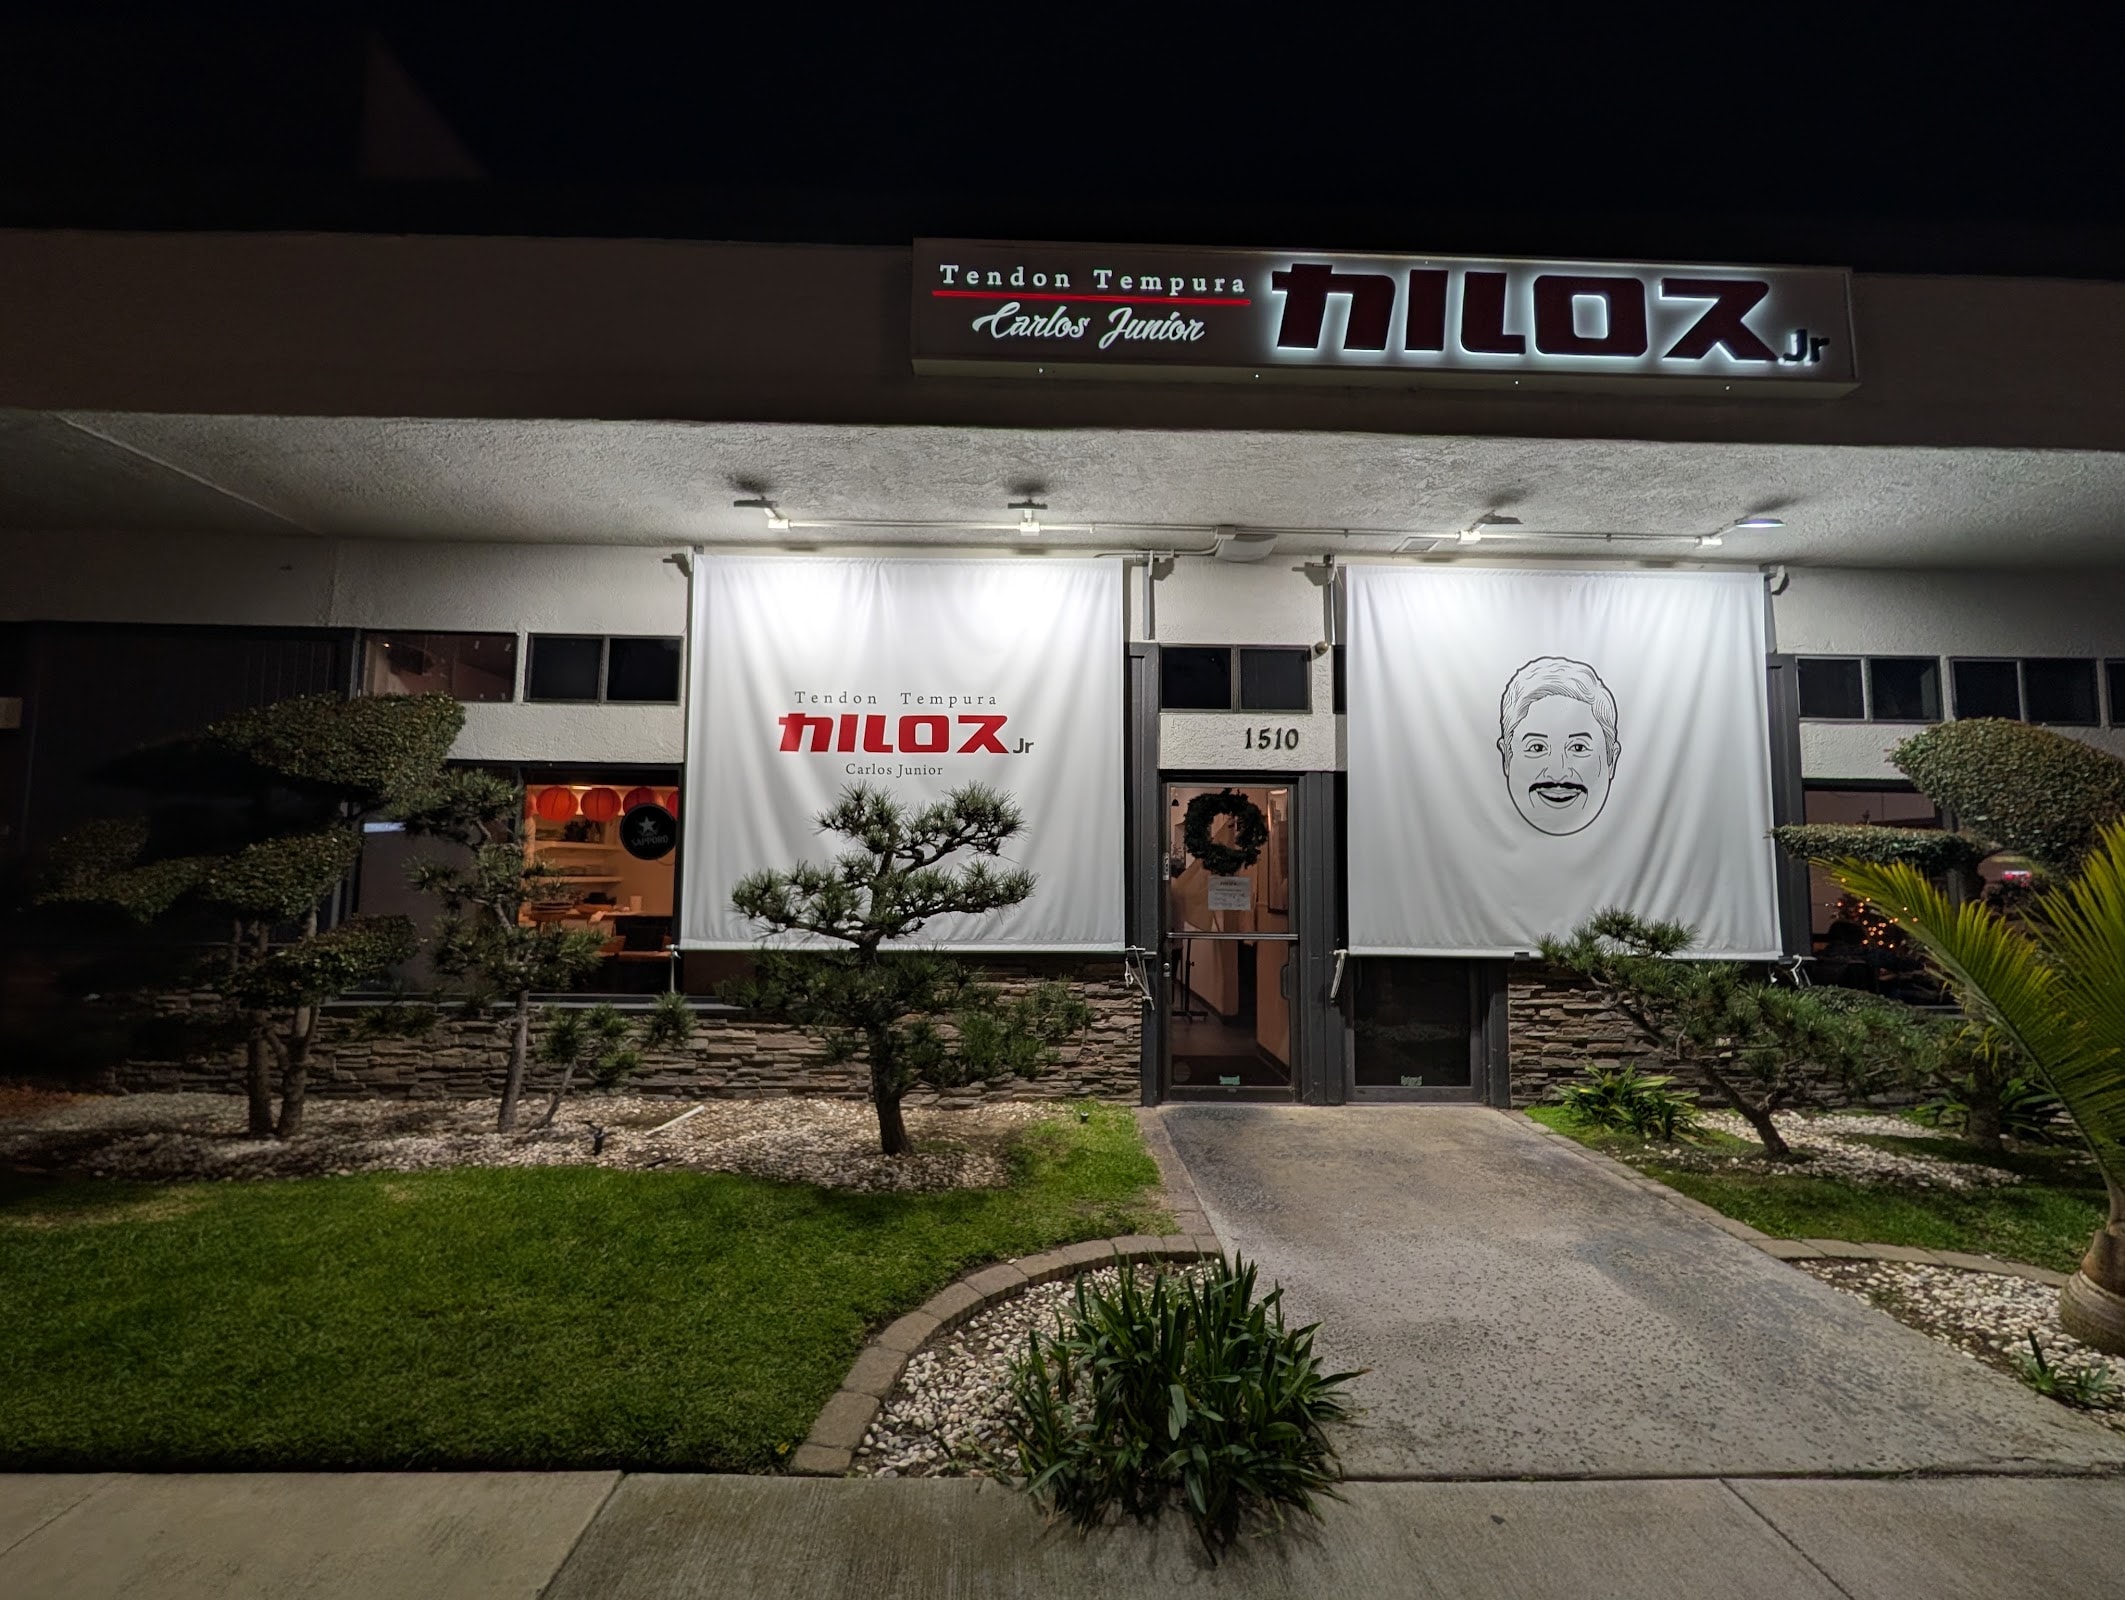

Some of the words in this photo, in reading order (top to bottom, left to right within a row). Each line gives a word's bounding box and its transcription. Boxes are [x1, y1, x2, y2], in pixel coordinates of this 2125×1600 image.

[940, 264, 1071, 288] Tendon
[1093, 269, 1246, 296] Tempura
[972, 302, 1090, 339] Carlos
[1098, 306, 1207, 350] Junior
[1271, 262, 1780, 362] カルロス
[1779, 329, 1831, 368] Jr
[794, 690, 878, 705] Tendon
[900, 692, 997, 708] Tempura
[778, 713, 1010, 754] カルロス
[1012, 737, 1035, 754] Jr
[1245, 727, 1299, 751] 1510
[845, 763, 893, 776] Carlos
[896, 764, 944, 779] Junior
